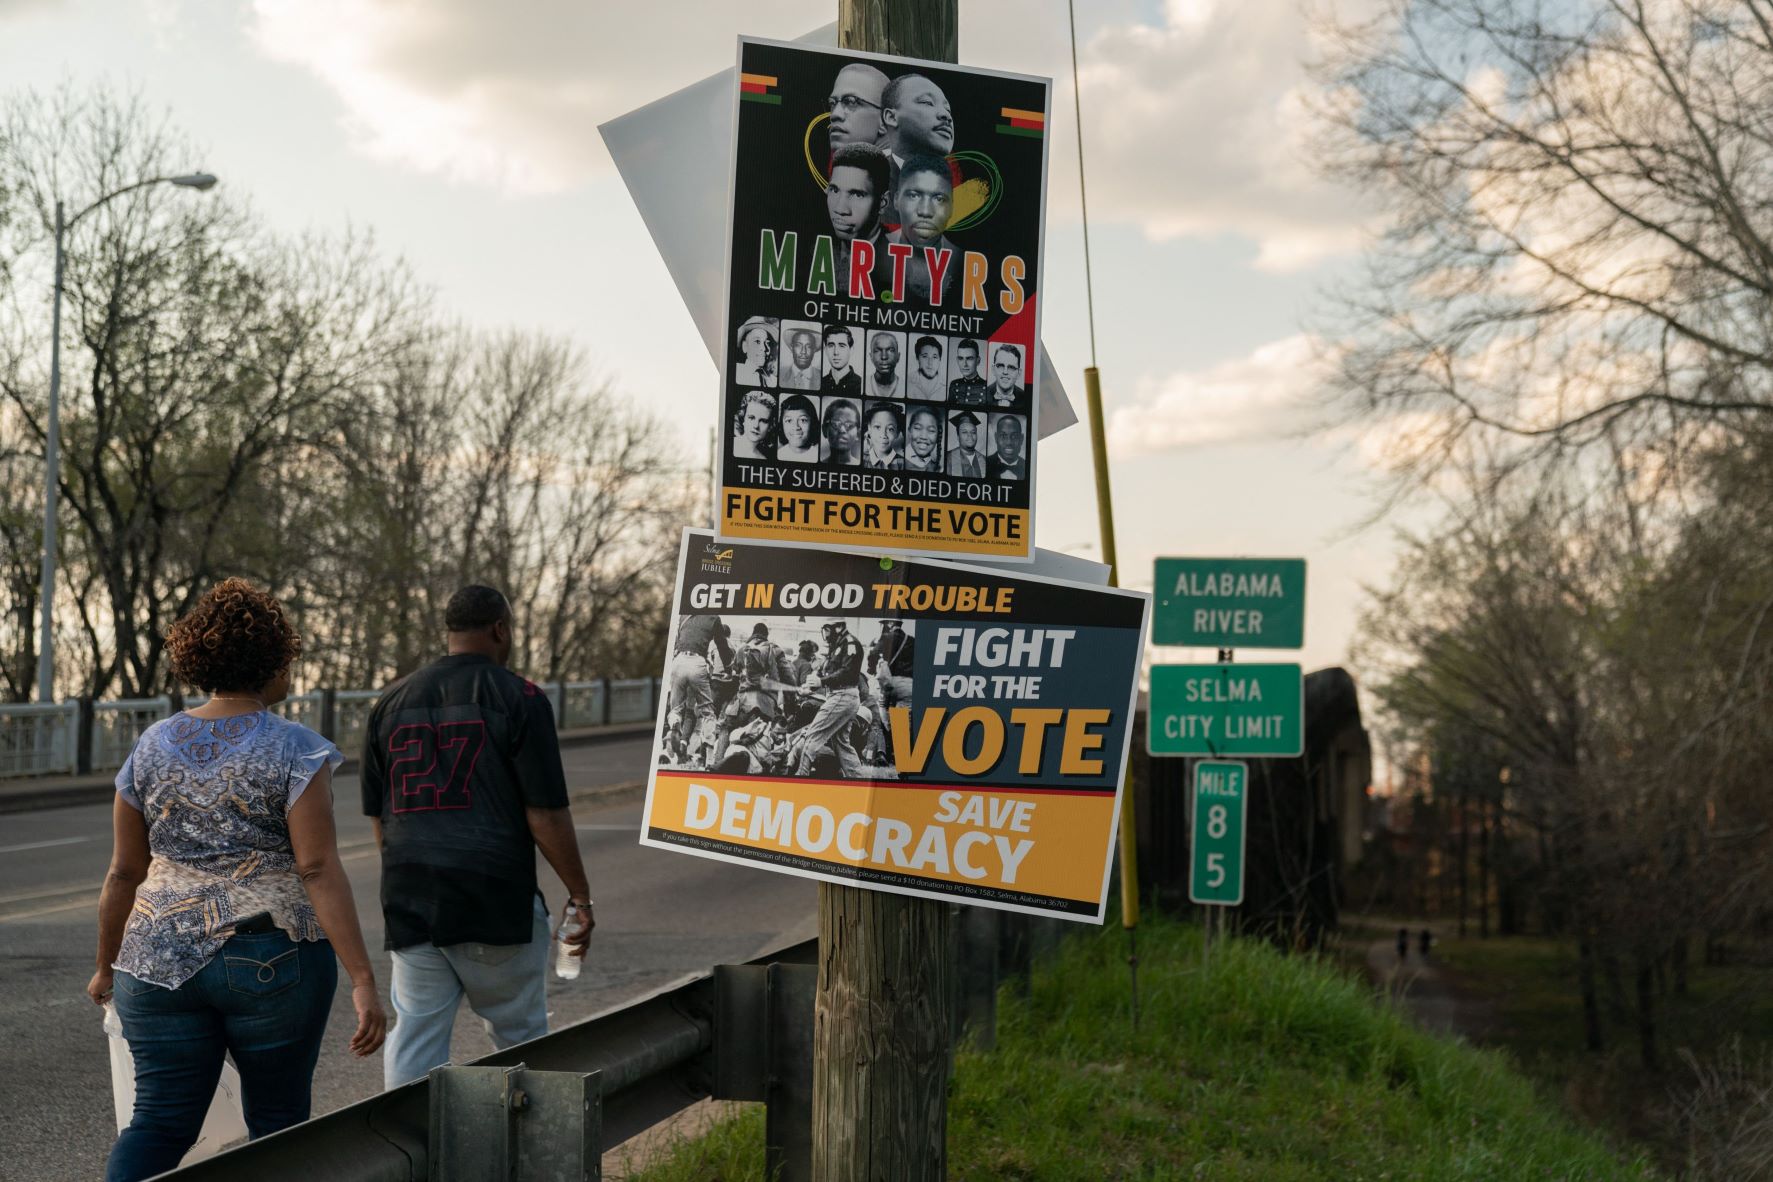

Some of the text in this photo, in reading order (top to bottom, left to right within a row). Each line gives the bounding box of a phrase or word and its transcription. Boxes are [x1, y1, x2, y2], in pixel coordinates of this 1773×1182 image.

[758, 229, 1026, 315] MARTYRS
[804, 301, 983, 333] OF THE MOVEMENT
[738, 465, 1012, 502] THEY SUFFERED & DIED FOR IT
[726, 494, 1021, 539] FIGHT FOR THE VOTE
[701, 563, 731, 574] JUBILEE
[1174, 572, 1283, 597] ALABAMA
[690, 583, 1015, 614] GET IN GOOD TROUBLE
[1193, 609, 1263, 634] RIVER
[933, 627, 1076, 668] FIGHT
[932, 675, 1042, 700] FOR THE
[1185, 678, 1262, 702] SELMA
[888, 706, 1112, 777] VOTE
[1164, 715, 1284, 739] CITY LIMIT
[389, 719, 485, 815] 27
[1199, 771, 1240, 796] MILE
[934, 790, 1036, 833] SAVE
[1207, 805, 1228, 839] 8
[683, 783, 1036, 884] DEMOCRACY
[689, 837, 700, 845] this
[700, 840, 712, 848] sign
[712, 842, 733, 852] without
[733, 846, 743, 854] the
[743, 849, 774, 860] permission
[792, 857, 811, 867] Bridge
[811, 861, 836, 873] Crossing
[858, 871, 879, 880] please
[881, 874, 897, 882] send
[903, 877, 915, 885] $10
[916, 879, 945, 889] donation
[965, 886, 977, 894] Box
[979, 888, 996, 898] 1582,
[998, 891, 1018, 901] Selma,
[1020, 895, 1047, 905] Alabama
[1206, 853, 1226, 888] 5
